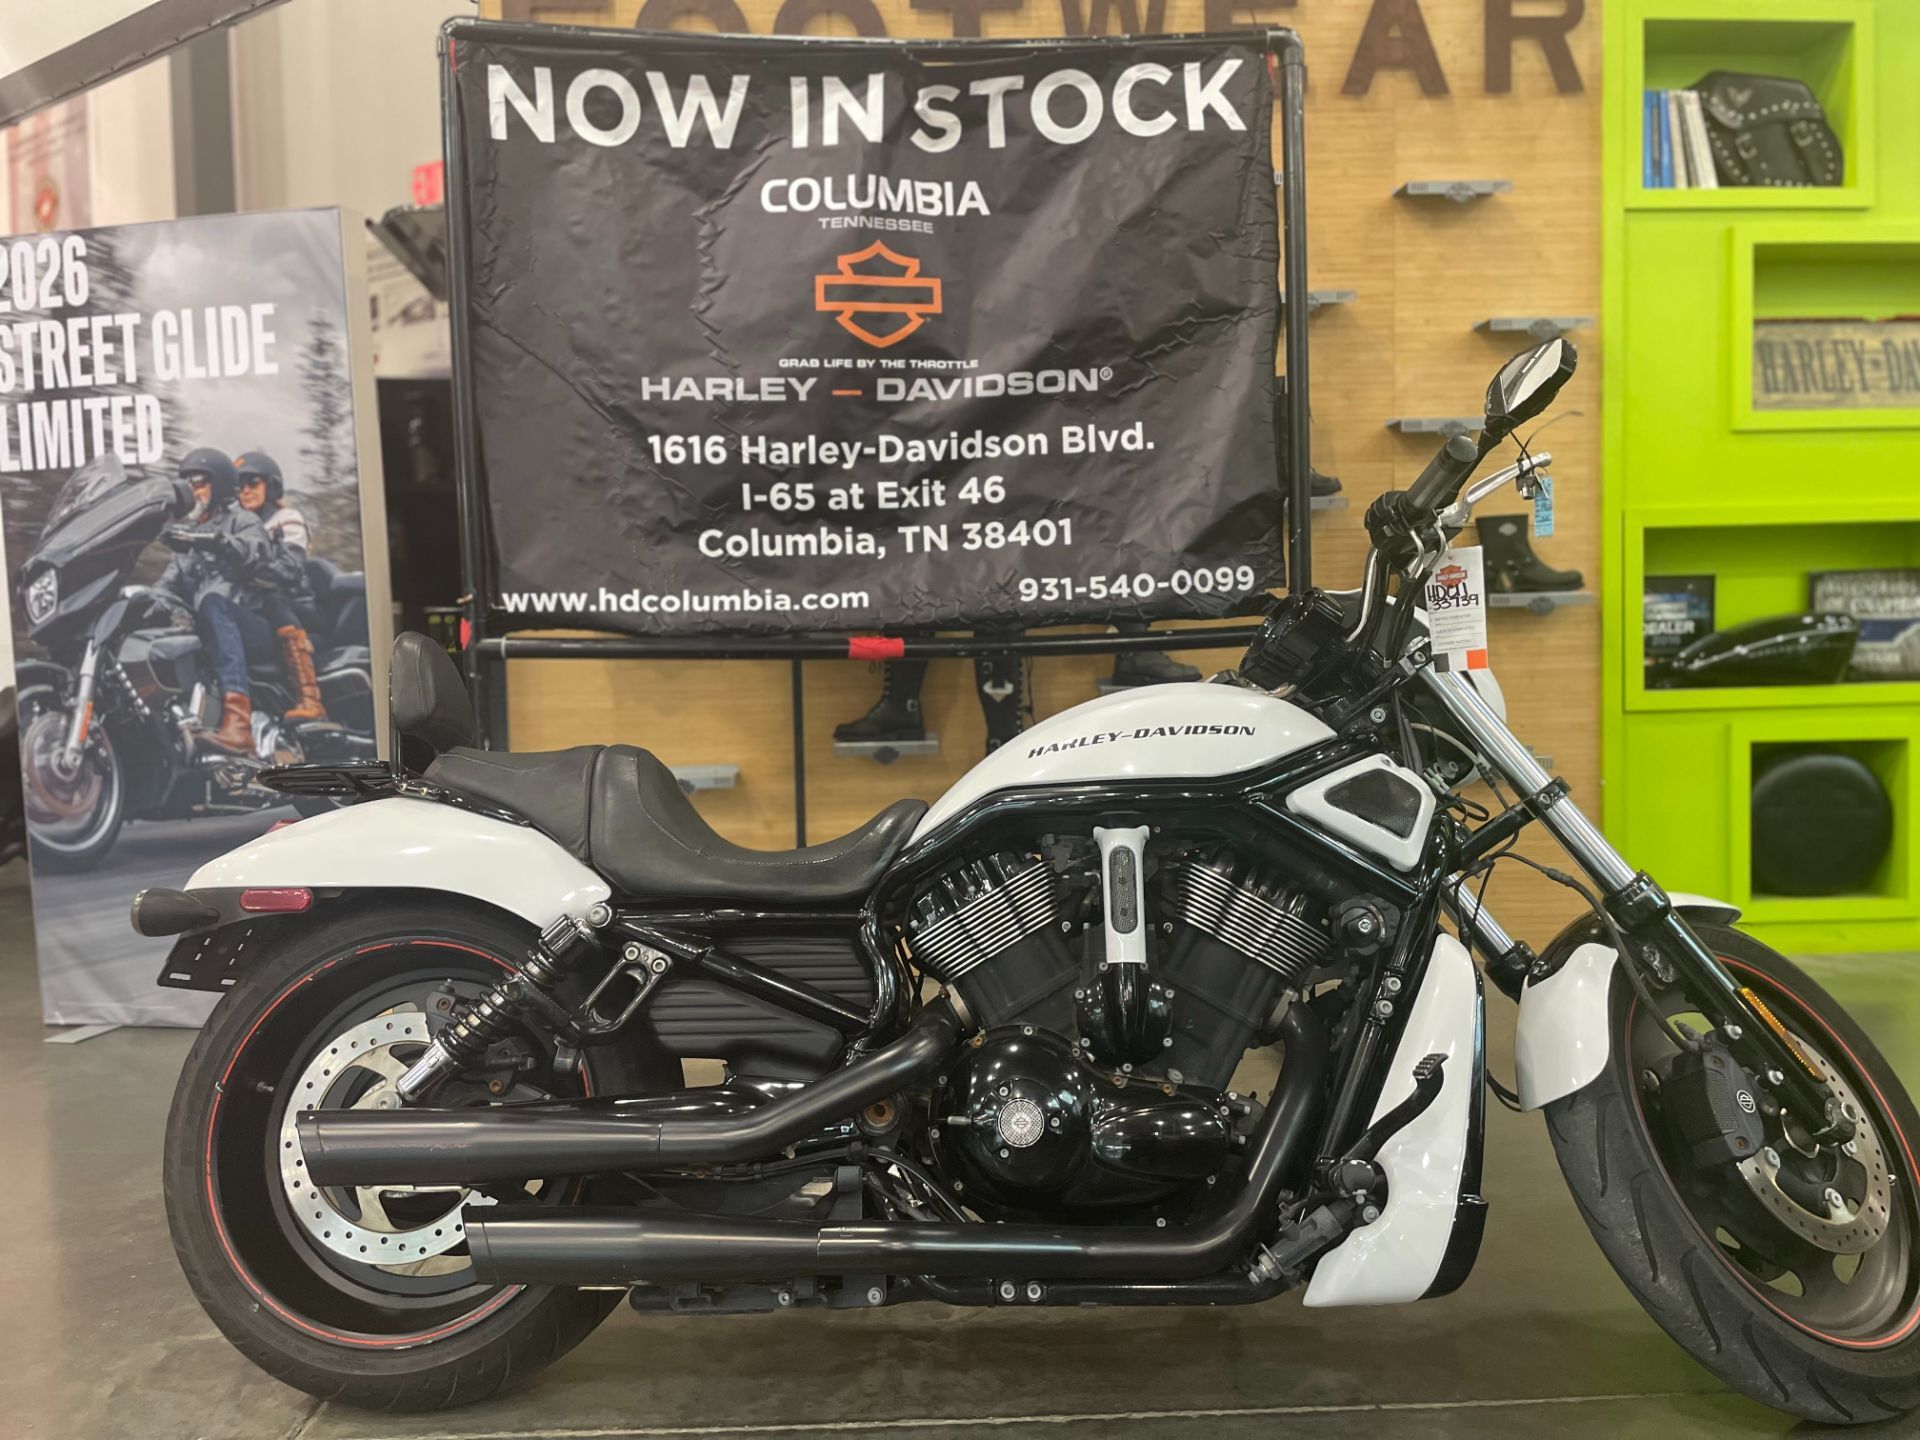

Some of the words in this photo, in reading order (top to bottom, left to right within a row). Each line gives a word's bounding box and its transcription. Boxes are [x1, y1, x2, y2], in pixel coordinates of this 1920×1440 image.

[488, 64, 751, 149] NOW
[790, 73, 884, 149] IN
[910, 58, 1247, 153] STOCK
[761, 174, 991, 217] COLUMBIA
[818, 216, 934, 234] TENNESSEE
[0, 313, 141, 394] STREET
[152, 303, 279, 382] GLIDE
[779, 358, 820, 368] GRAB
[824, 358, 853, 368] LIFE
[857, 358, 876, 368] BY
[880, 359, 906, 368] THE
[909, 358, 979, 369] THROTTLE
[641, 377, 818, 401] HARLEY
[0, 394, 163, 473] LIMITED
[648, 434, 728, 465] 1616
[741, 429, 1048, 470] Harley-Davidson
[1062, 421, 1155, 454] Blvd.
[742, 482, 816, 512] I-65
[828, 486, 865, 511] at
[877, 479, 946, 510] Exit
[958, 475, 1006, 504] 46
[698, 526, 887, 560] Columbia,
[898, 524, 949, 554] TN
[962, 518, 1073, 552] 38401
[501, 587, 870, 614] www.hdcolumbia.com
[1018, 565, 1255, 603] 931-540-0099
[1028, 724, 1256, 759] HARLEY-DAVIDSON
